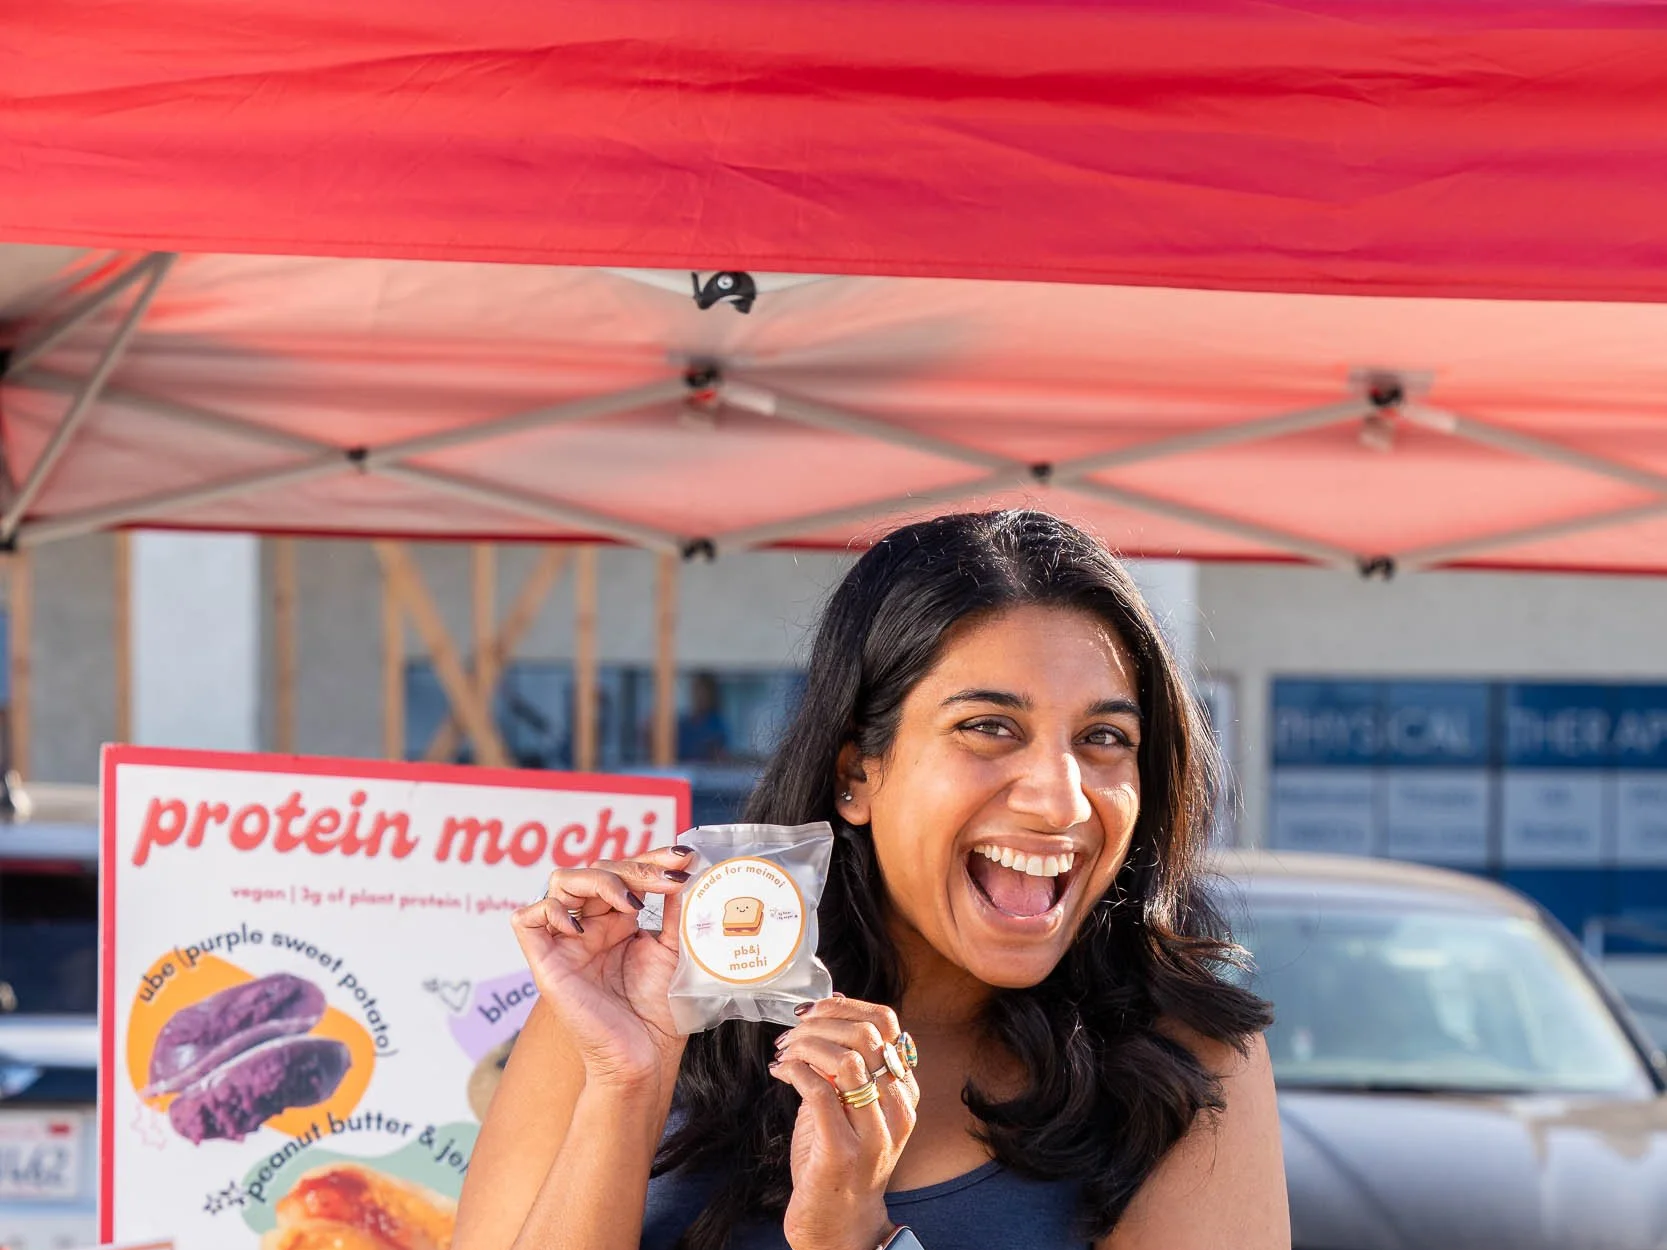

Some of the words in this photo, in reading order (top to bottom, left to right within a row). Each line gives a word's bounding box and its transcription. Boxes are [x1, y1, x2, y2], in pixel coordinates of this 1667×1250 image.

[132, 790, 420, 867] protein
[435, 807, 657, 868] mochi
[232, 887, 286, 902] vegan
[302, 887, 322, 905] 3g
[328, 887, 344, 902] of
[350, 889, 394, 908] plant
[400, 892, 461, 909] protein
[697, 873, 722, 898] made
[725, 866, 741, 876] for
[729, 956, 768, 971] mochi
[733, 944, 760, 959] pb&j
[139, 960, 177, 1004] ube
[175, 923, 264, 969] (purple
[271, 931, 343, 973] sweet
[338, 973, 400, 1058] potato)
[477, 981, 539, 1025] blac
[248, 1122, 322, 1204] peanut
[327, 1111, 412, 1137] butter
[418, 1125, 437, 1149] &
